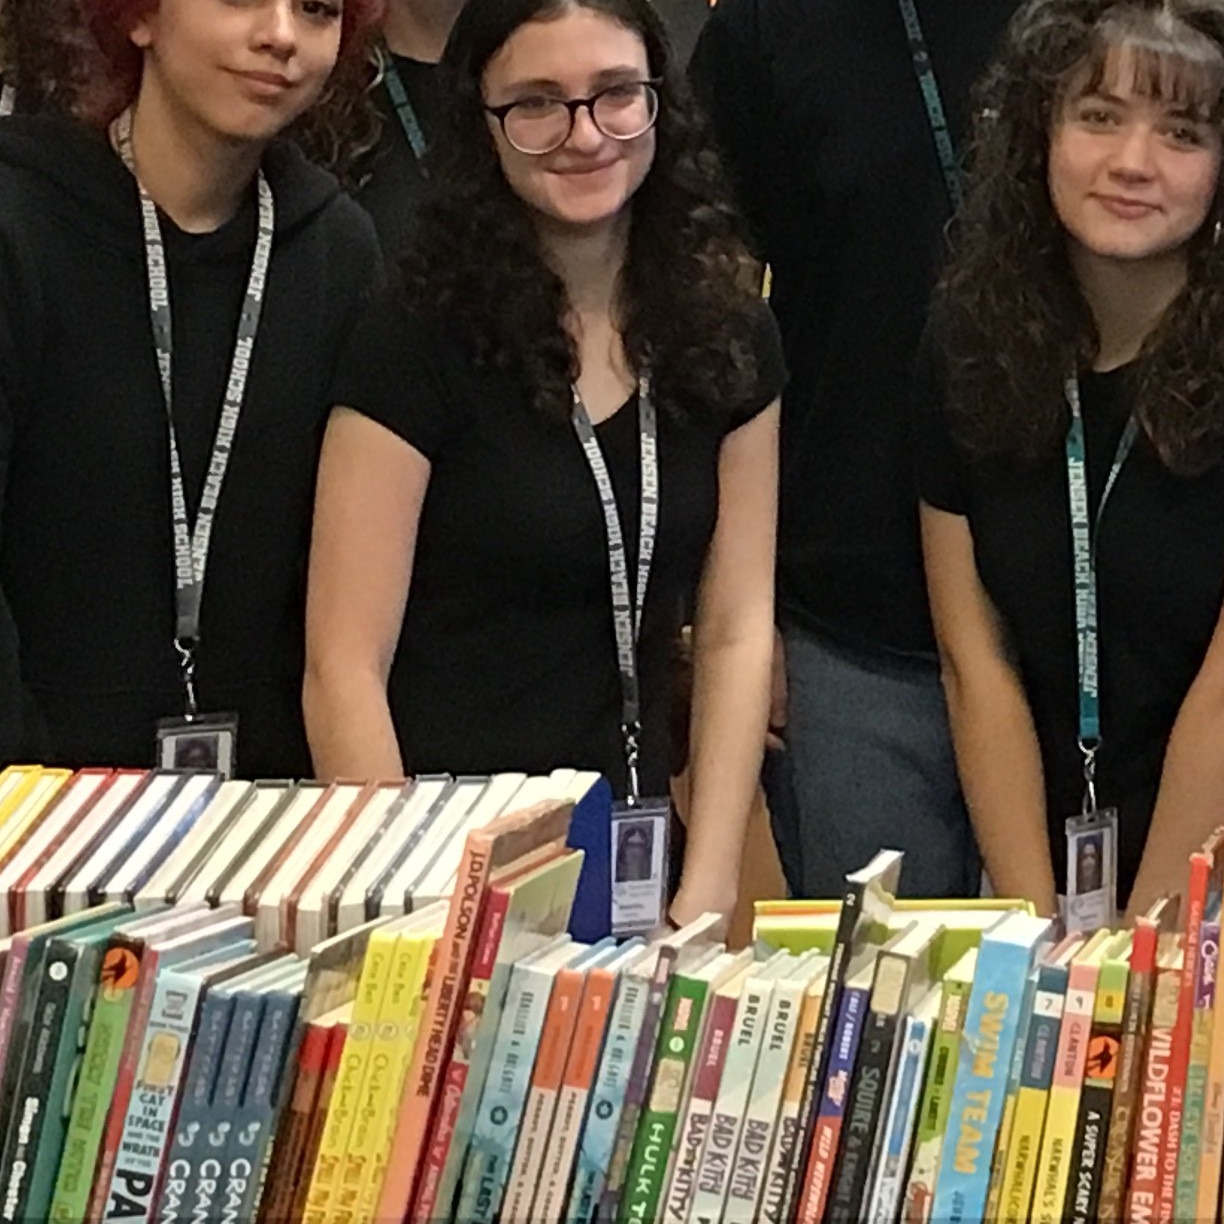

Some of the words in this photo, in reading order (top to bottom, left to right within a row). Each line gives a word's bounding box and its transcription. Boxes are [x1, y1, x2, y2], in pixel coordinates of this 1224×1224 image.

[146, 244, 169, 312] SCHOOL
[247, 232, 272, 302] JENSEN
[224, 336, 254, 404] SCHOOL
[215, 404, 241, 448] HIGH
[199, 451, 230, 509] BEACH
[582, 436, 615, 501] SCHOOL
[641, 432, 658, 497] JENSEN
[1067, 457, 1089, 522] JENSEN
[174, 523, 194, 589] SCHOOL
[639, 503, 657, 562] BEACH
[1072, 528, 1091, 582] BEACH
[609, 550, 630, 606] BEACH
[613, 610, 635, 677] JENSEN
[433, 975, 457, 1030] LIBERTY
[738, 993, 761, 1047] BRUEL
[769, 999, 792, 1051] BRUEL
[422, 1029, 445, 1066] HEAD
[971, 990, 1010, 1078] SWIM
[1063, 1021, 1082, 1078] CLANTON
[139, 1093, 166, 1108] CAT
[416, 1066, 434, 1098] DIME
[851, 1065, 880, 1133] SQUIRE
[18, 1097, 39, 1144] Simon
[127, 1115, 165, 1133] SPACE
[142, 1105, 158, 1118] IN
[709, 1112, 738, 1153] BAD
[743, 1118, 771, 1156] BAD
[953, 1089, 992, 1174] TEAM
[1165, 1109, 1181, 1153] DASH
[121, 1141, 161, 1158] WRATH
[634, 1121, 665, 1195] HULK
[1081, 1123, 1100, 1169] SUPER
[2, 1160, 27, 1221] Chester
[668, 1167, 694, 1221] KITTY
[698, 1150, 729, 1197] KITTY
[1074, 1169, 1093, 1218] SCARY
